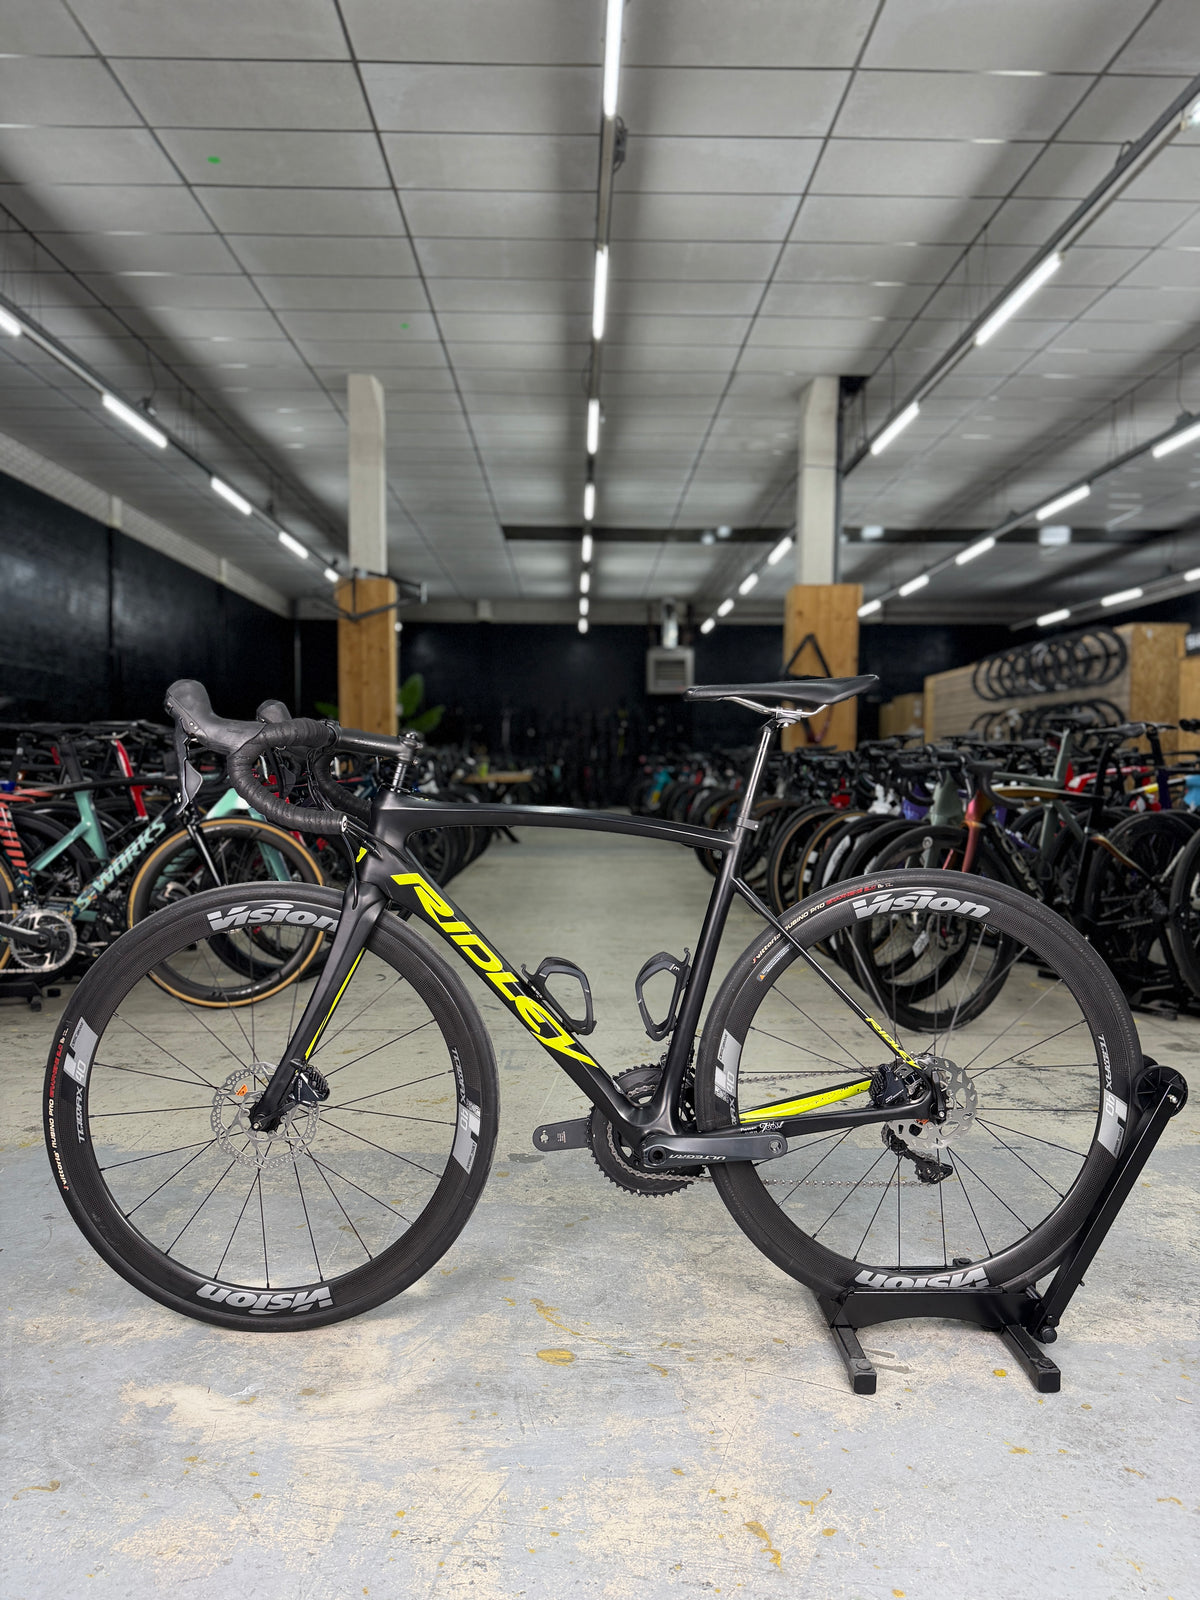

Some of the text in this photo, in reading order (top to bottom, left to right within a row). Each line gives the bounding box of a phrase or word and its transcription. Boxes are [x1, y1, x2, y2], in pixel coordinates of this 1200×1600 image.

[75, 815, 167, 912] S-WORKS
[206, 903, 339, 932] Vision
[852, 890, 991, 919] Vision
[390, 873, 600, 1068] RIDLEY
[865, 1017, 922, 1070] RIDLEY
[75, 1060, 87, 1082] 40
[726, 1071, 735, 1093] 40
[460, 1108, 469, 1131] 40
[1105, 1095, 1115, 1117] 40
[49, 1118, 57, 1149] RUBINO
[53, 1151, 67, 1185] vittoria
[196, 1284, 334, 1315] Vision
